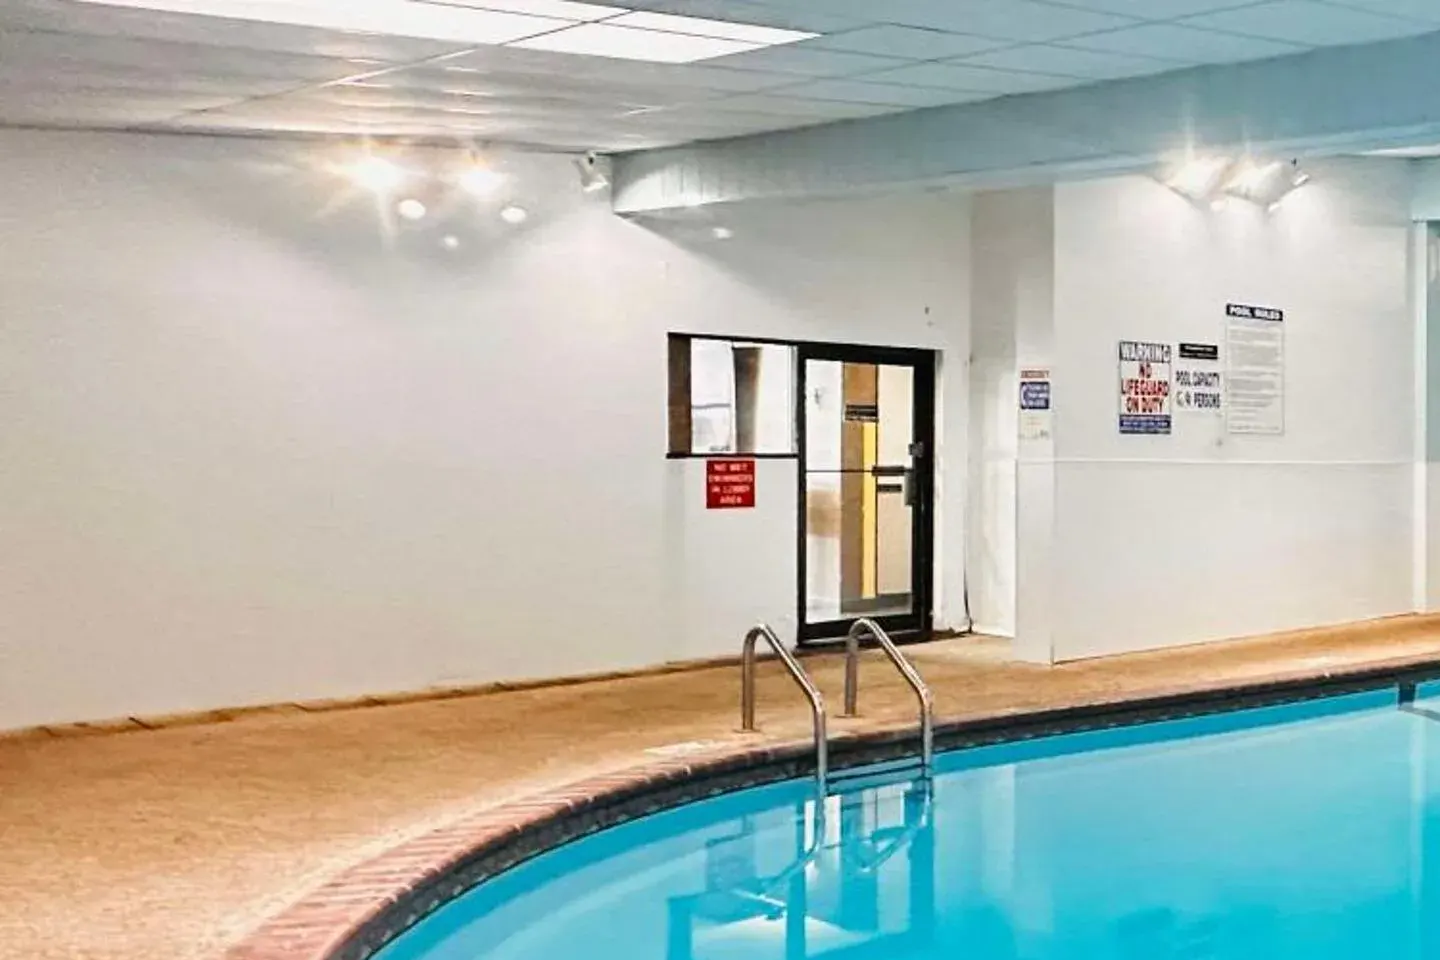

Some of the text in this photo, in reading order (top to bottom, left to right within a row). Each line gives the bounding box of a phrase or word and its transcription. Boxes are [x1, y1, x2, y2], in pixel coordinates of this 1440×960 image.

[1230, 305, 1251, 317] POOL
[1121, 342, 1170, 362] WARNING
[1139, 363, 1152, 379] NO
[1176, 370, 1220, 387] POOL CAPACITY
[1121, 379, 1169, 397] LIFEGUARD
[1126, 397, 1164, 413] ON DUTY
[1194, 393, 1220, 408] PERSONS
